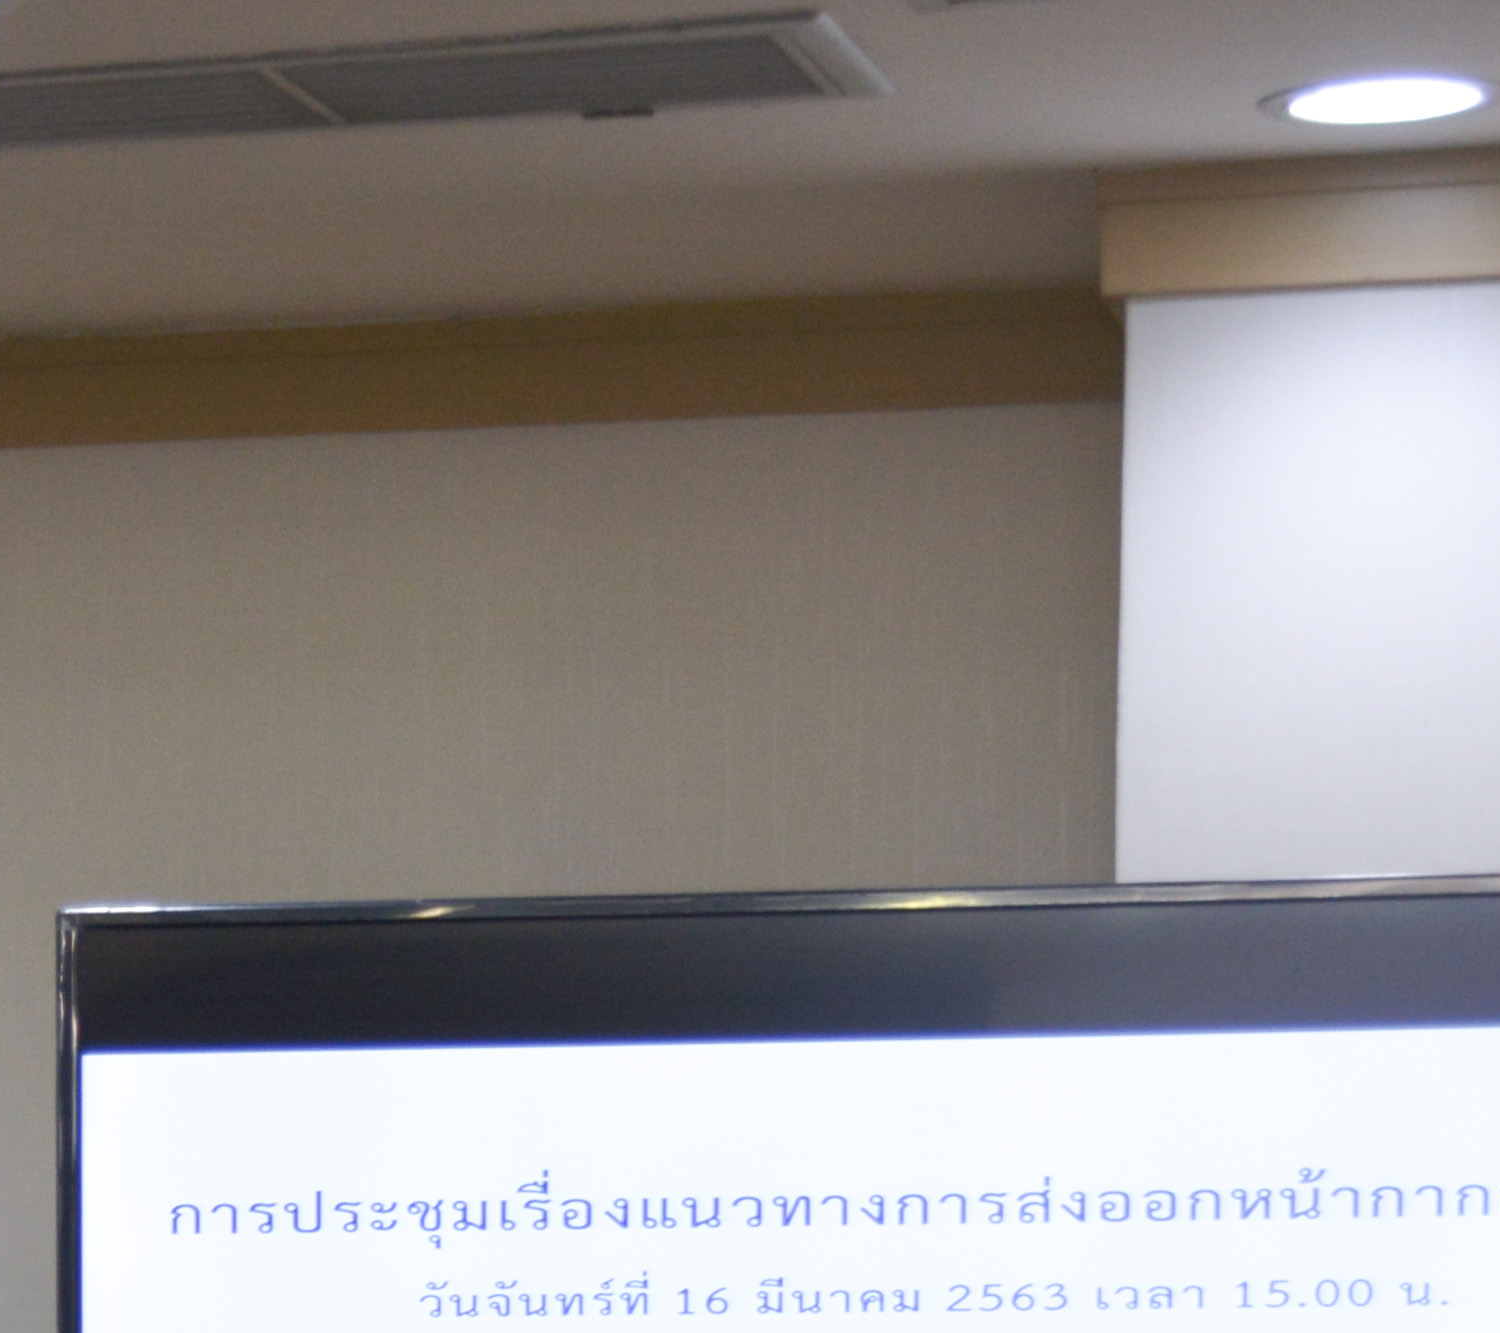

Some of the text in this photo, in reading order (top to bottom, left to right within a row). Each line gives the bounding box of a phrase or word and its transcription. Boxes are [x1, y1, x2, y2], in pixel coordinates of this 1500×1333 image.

[419, 1269, 1450, 1318] วันจันทร์ที่ 16 มีนาคม 2563 เวลา 15.00 น.
